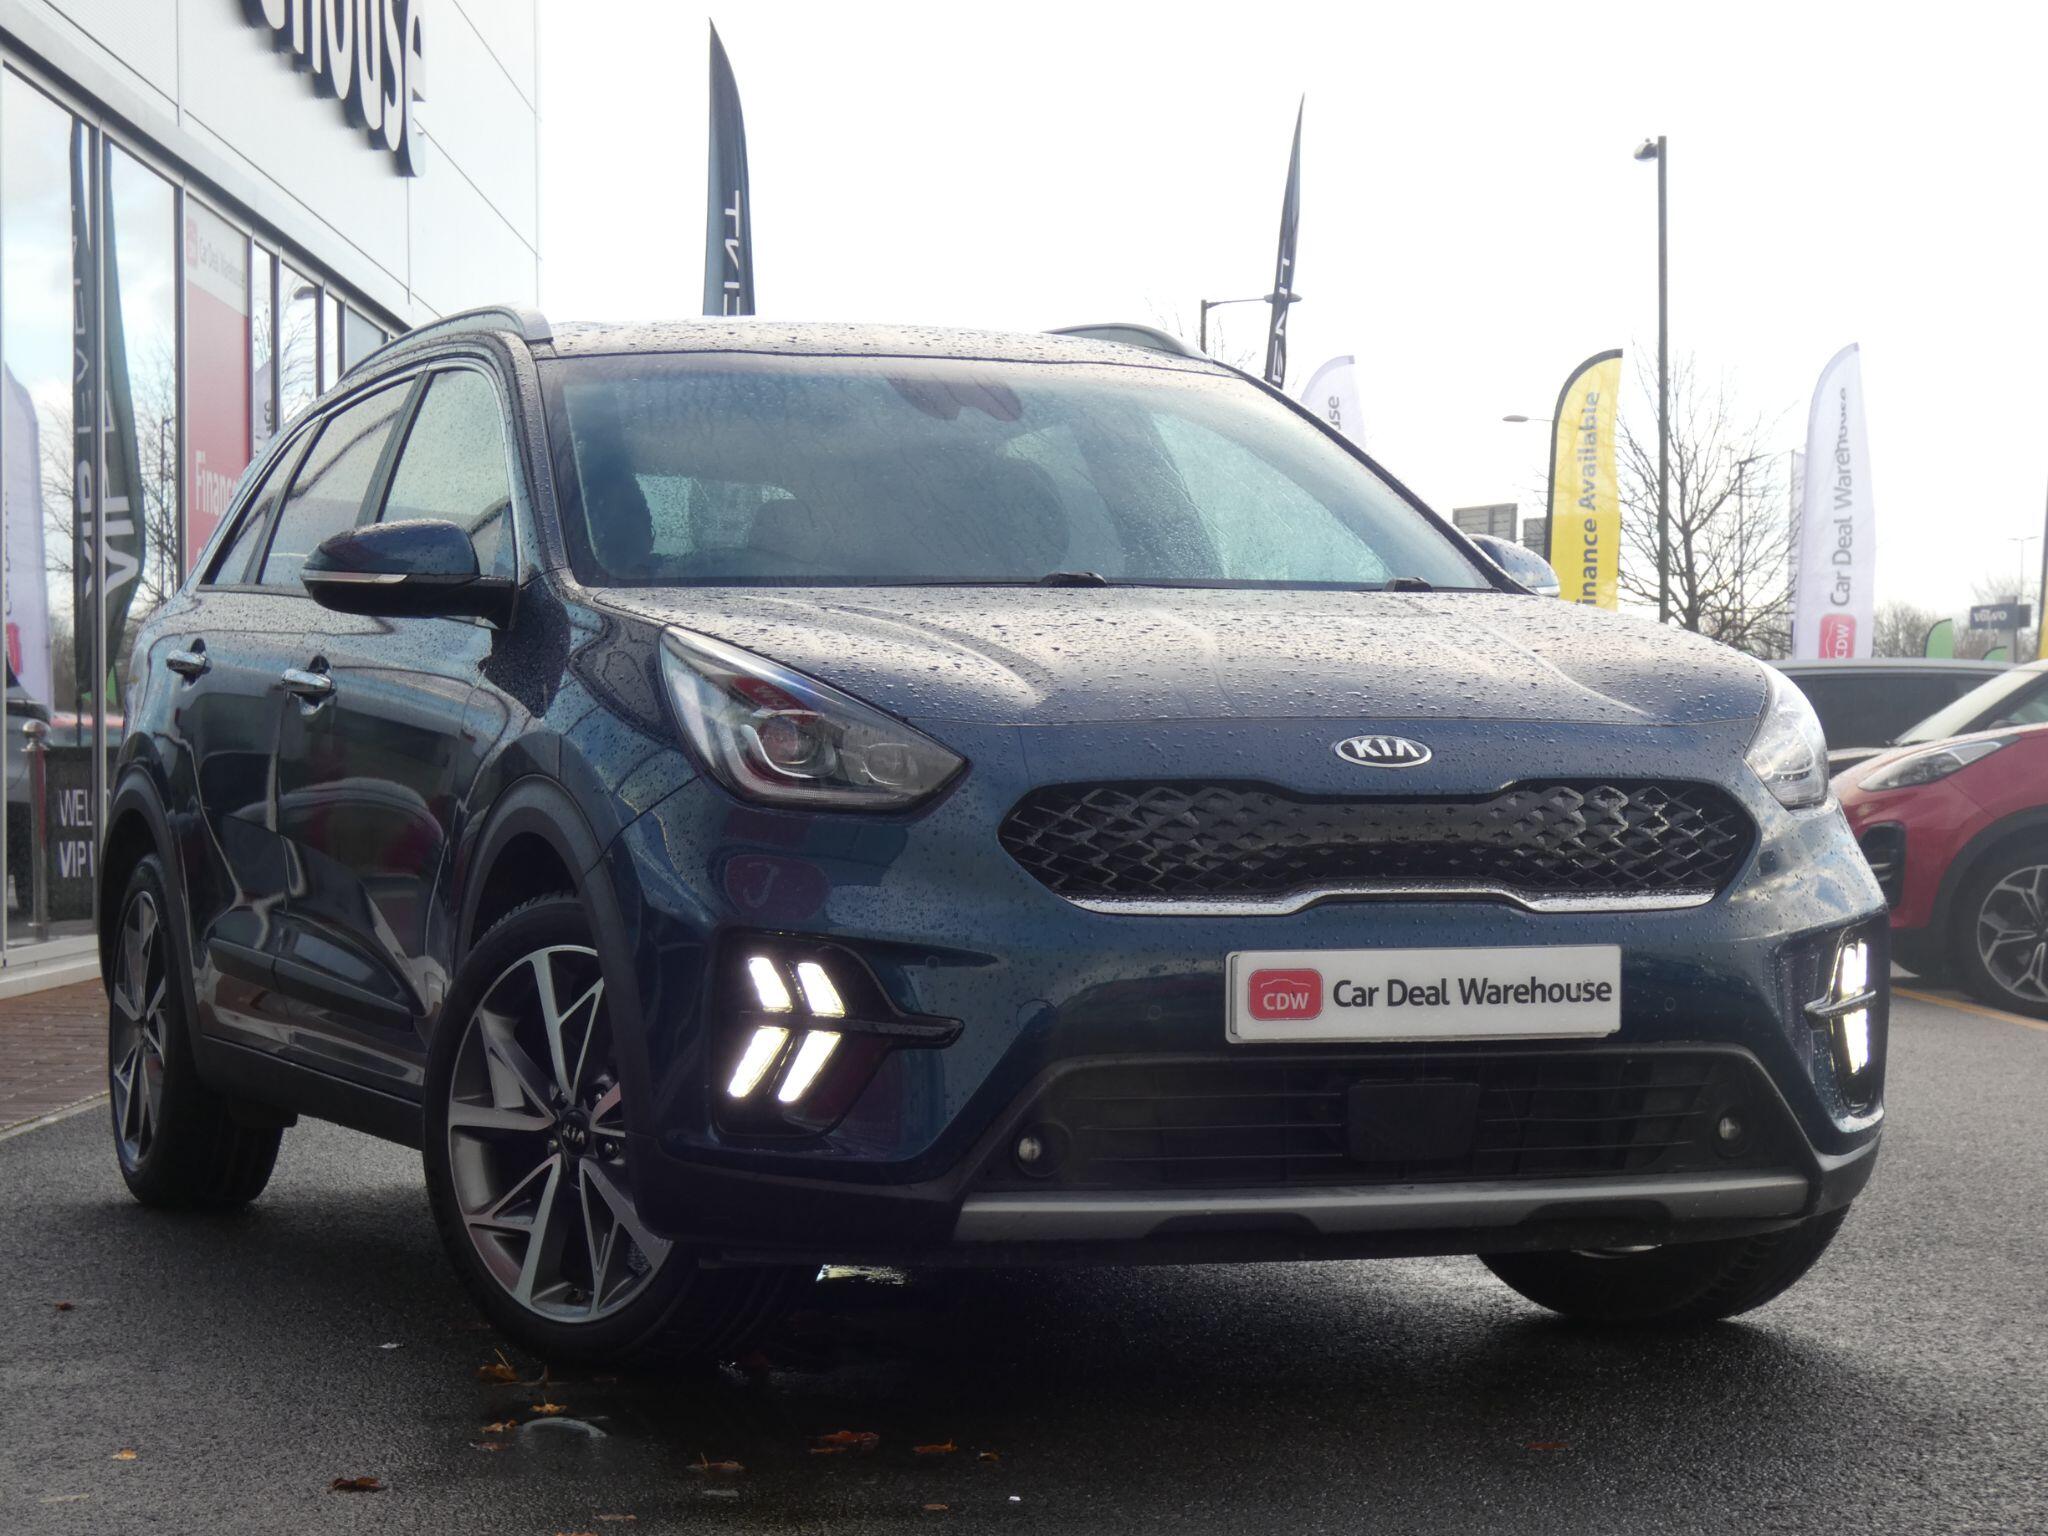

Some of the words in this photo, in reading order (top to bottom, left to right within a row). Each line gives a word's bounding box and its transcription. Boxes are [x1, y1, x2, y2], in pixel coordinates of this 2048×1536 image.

[262, 0, 425, 177] ouse
[1578, 392, 1600, 511] Available
[1833, 387, 1853, 511] Warehouse
[1832, 516, 1853, 566] Deal
[1830, 571, 1851, 607] Car
[1349, 738, 1421, 758] KIA
[59, 788, 94, 827] WEL
[1263, 992, 1310, 1011] CDW
[1333, 979, 1380, 1008] Car
[1387, 978, 1450, 1007] Deal
[1458, 976, 1613, 1006] Warehouse
